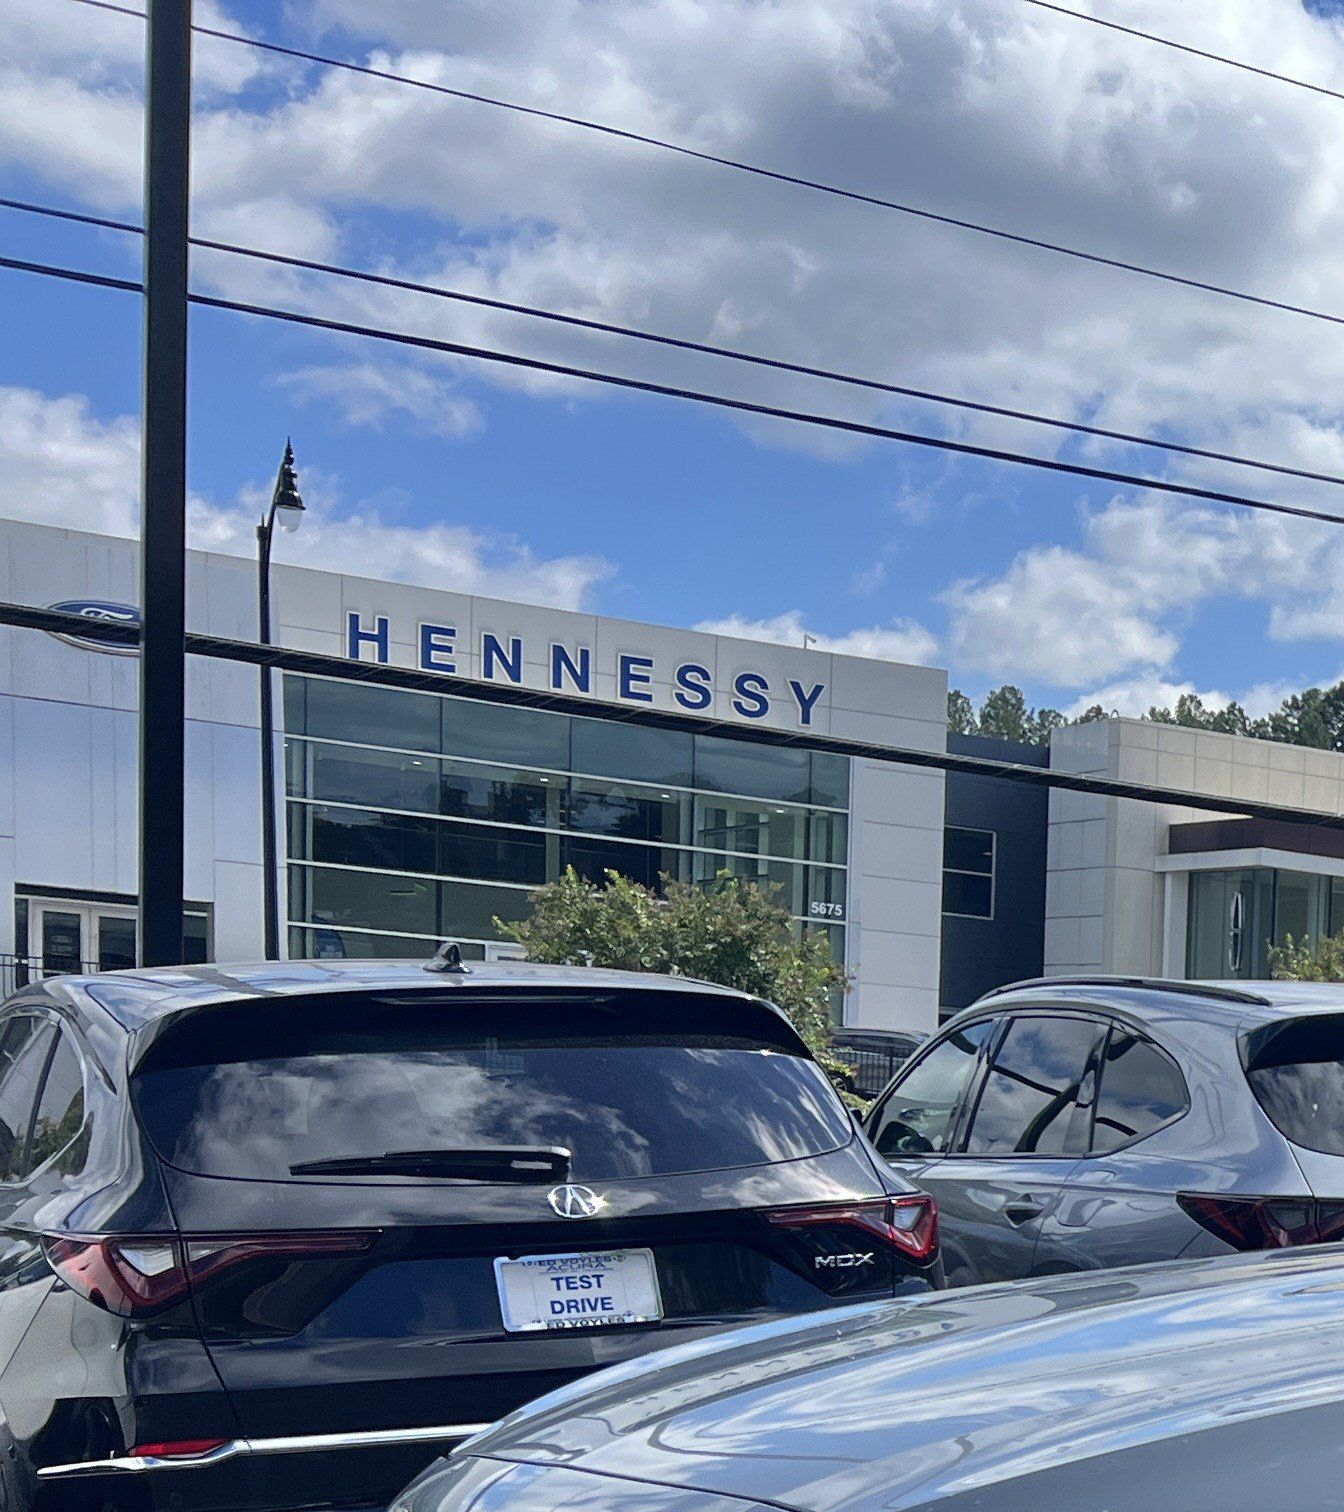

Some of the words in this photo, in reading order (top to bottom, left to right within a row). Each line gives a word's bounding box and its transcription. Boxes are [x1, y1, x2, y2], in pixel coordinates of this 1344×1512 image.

[345, 610, 826, 726] HENNESSY
[810, 901, 843, 917] 5675
[814, 1252, 876, 1269] MDX
[550, 1274, 605, 1291] TEST
[550, 1296, 615, 1315] DRIVE
